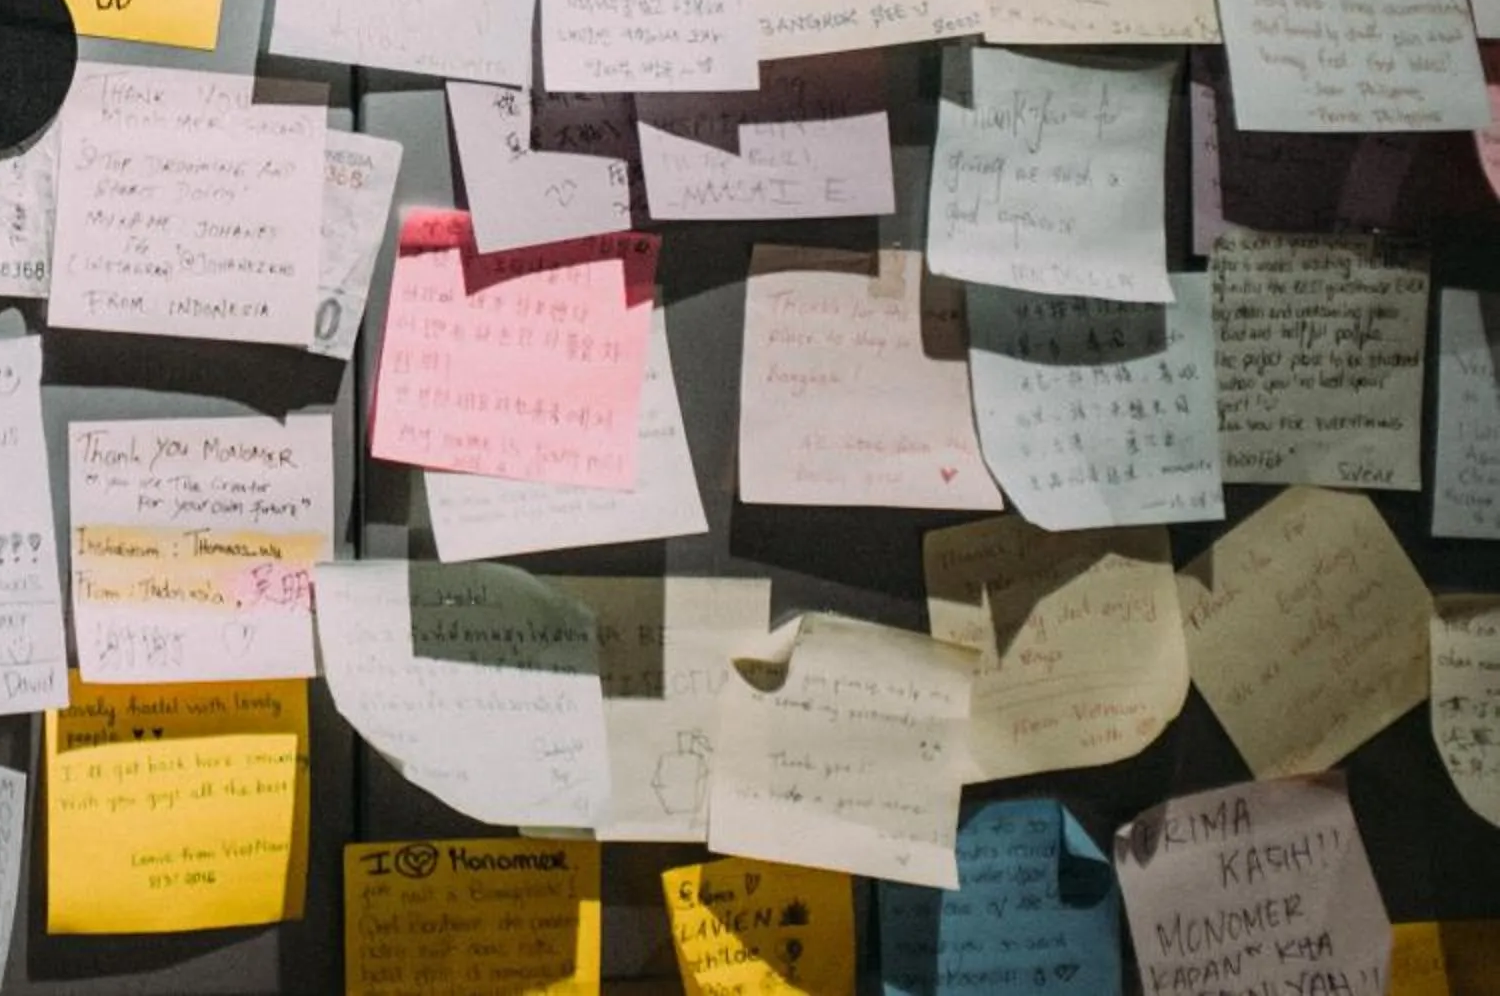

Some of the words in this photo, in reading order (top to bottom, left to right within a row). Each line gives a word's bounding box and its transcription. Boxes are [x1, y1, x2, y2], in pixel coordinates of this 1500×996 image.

[76, 429, 141, 466] Thank
[1164, 796, 1253, 852] RIMA
[360, 850, 392, 876] I
